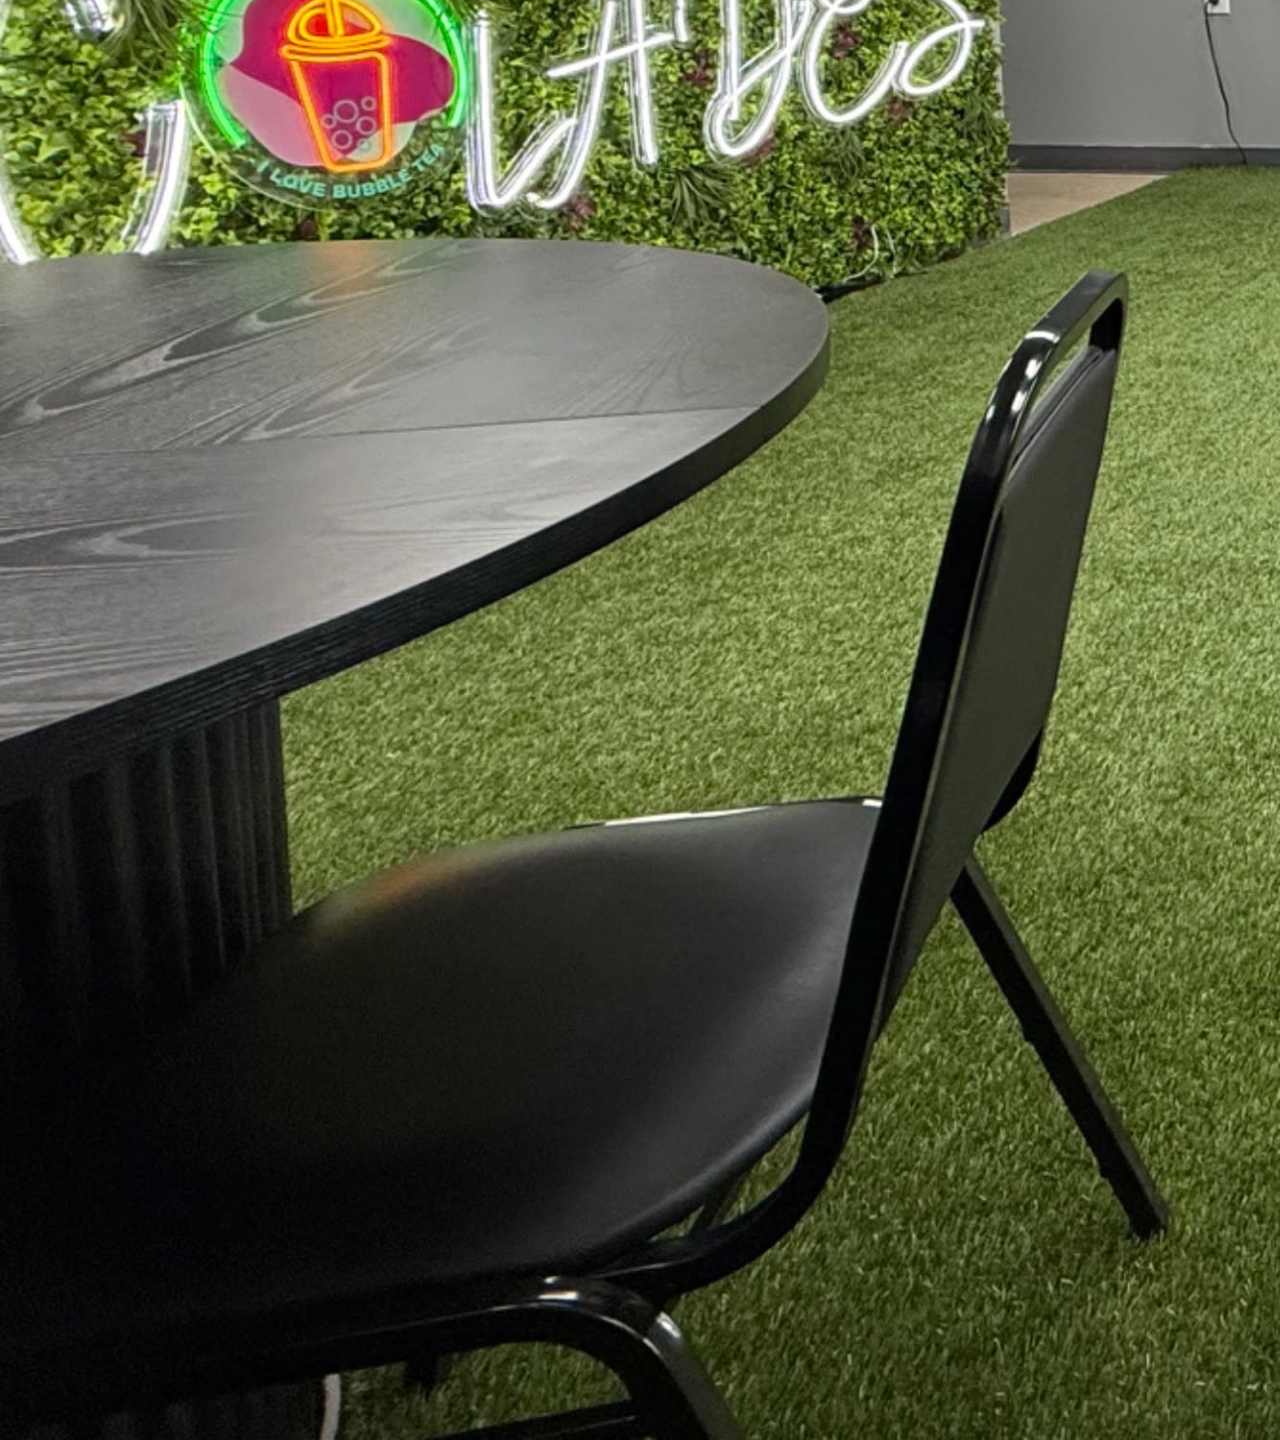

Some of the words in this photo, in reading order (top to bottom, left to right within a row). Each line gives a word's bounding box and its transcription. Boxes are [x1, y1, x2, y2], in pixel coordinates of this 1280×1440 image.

[270, 168, 326, 198] LOVE
[332, 168, 411, 198] BUBBLE
[413, 143, 444, 173] TEA
